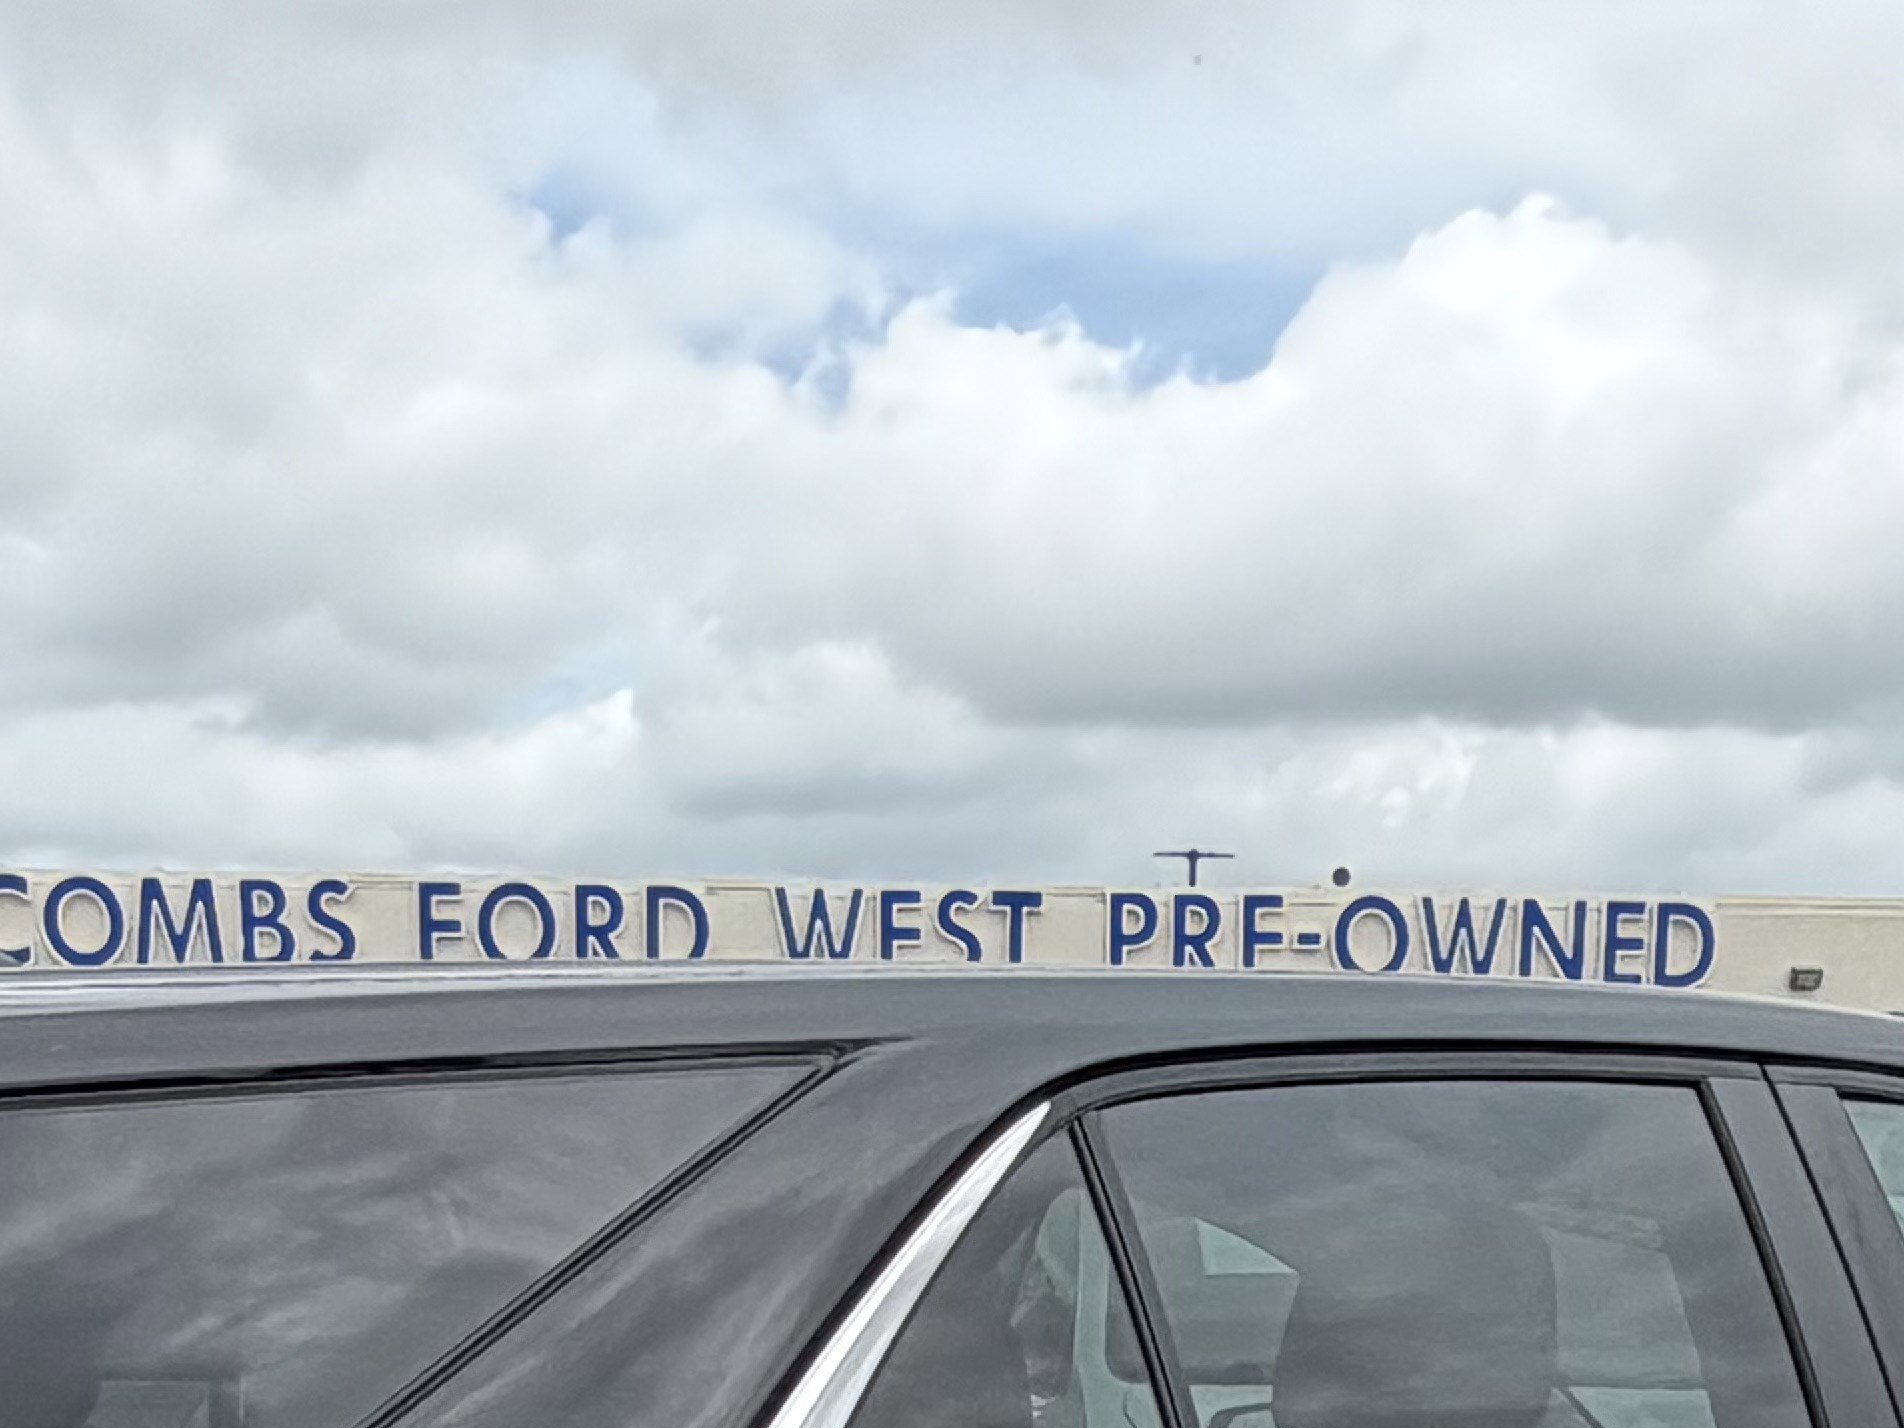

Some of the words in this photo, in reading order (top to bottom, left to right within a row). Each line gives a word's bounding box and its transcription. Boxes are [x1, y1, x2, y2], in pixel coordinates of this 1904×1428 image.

[417, 882, 709, 960] FORD
[775, 886, 1042, 962] WEST
[1109, 892, 1715, 988] PRE-OWNED
